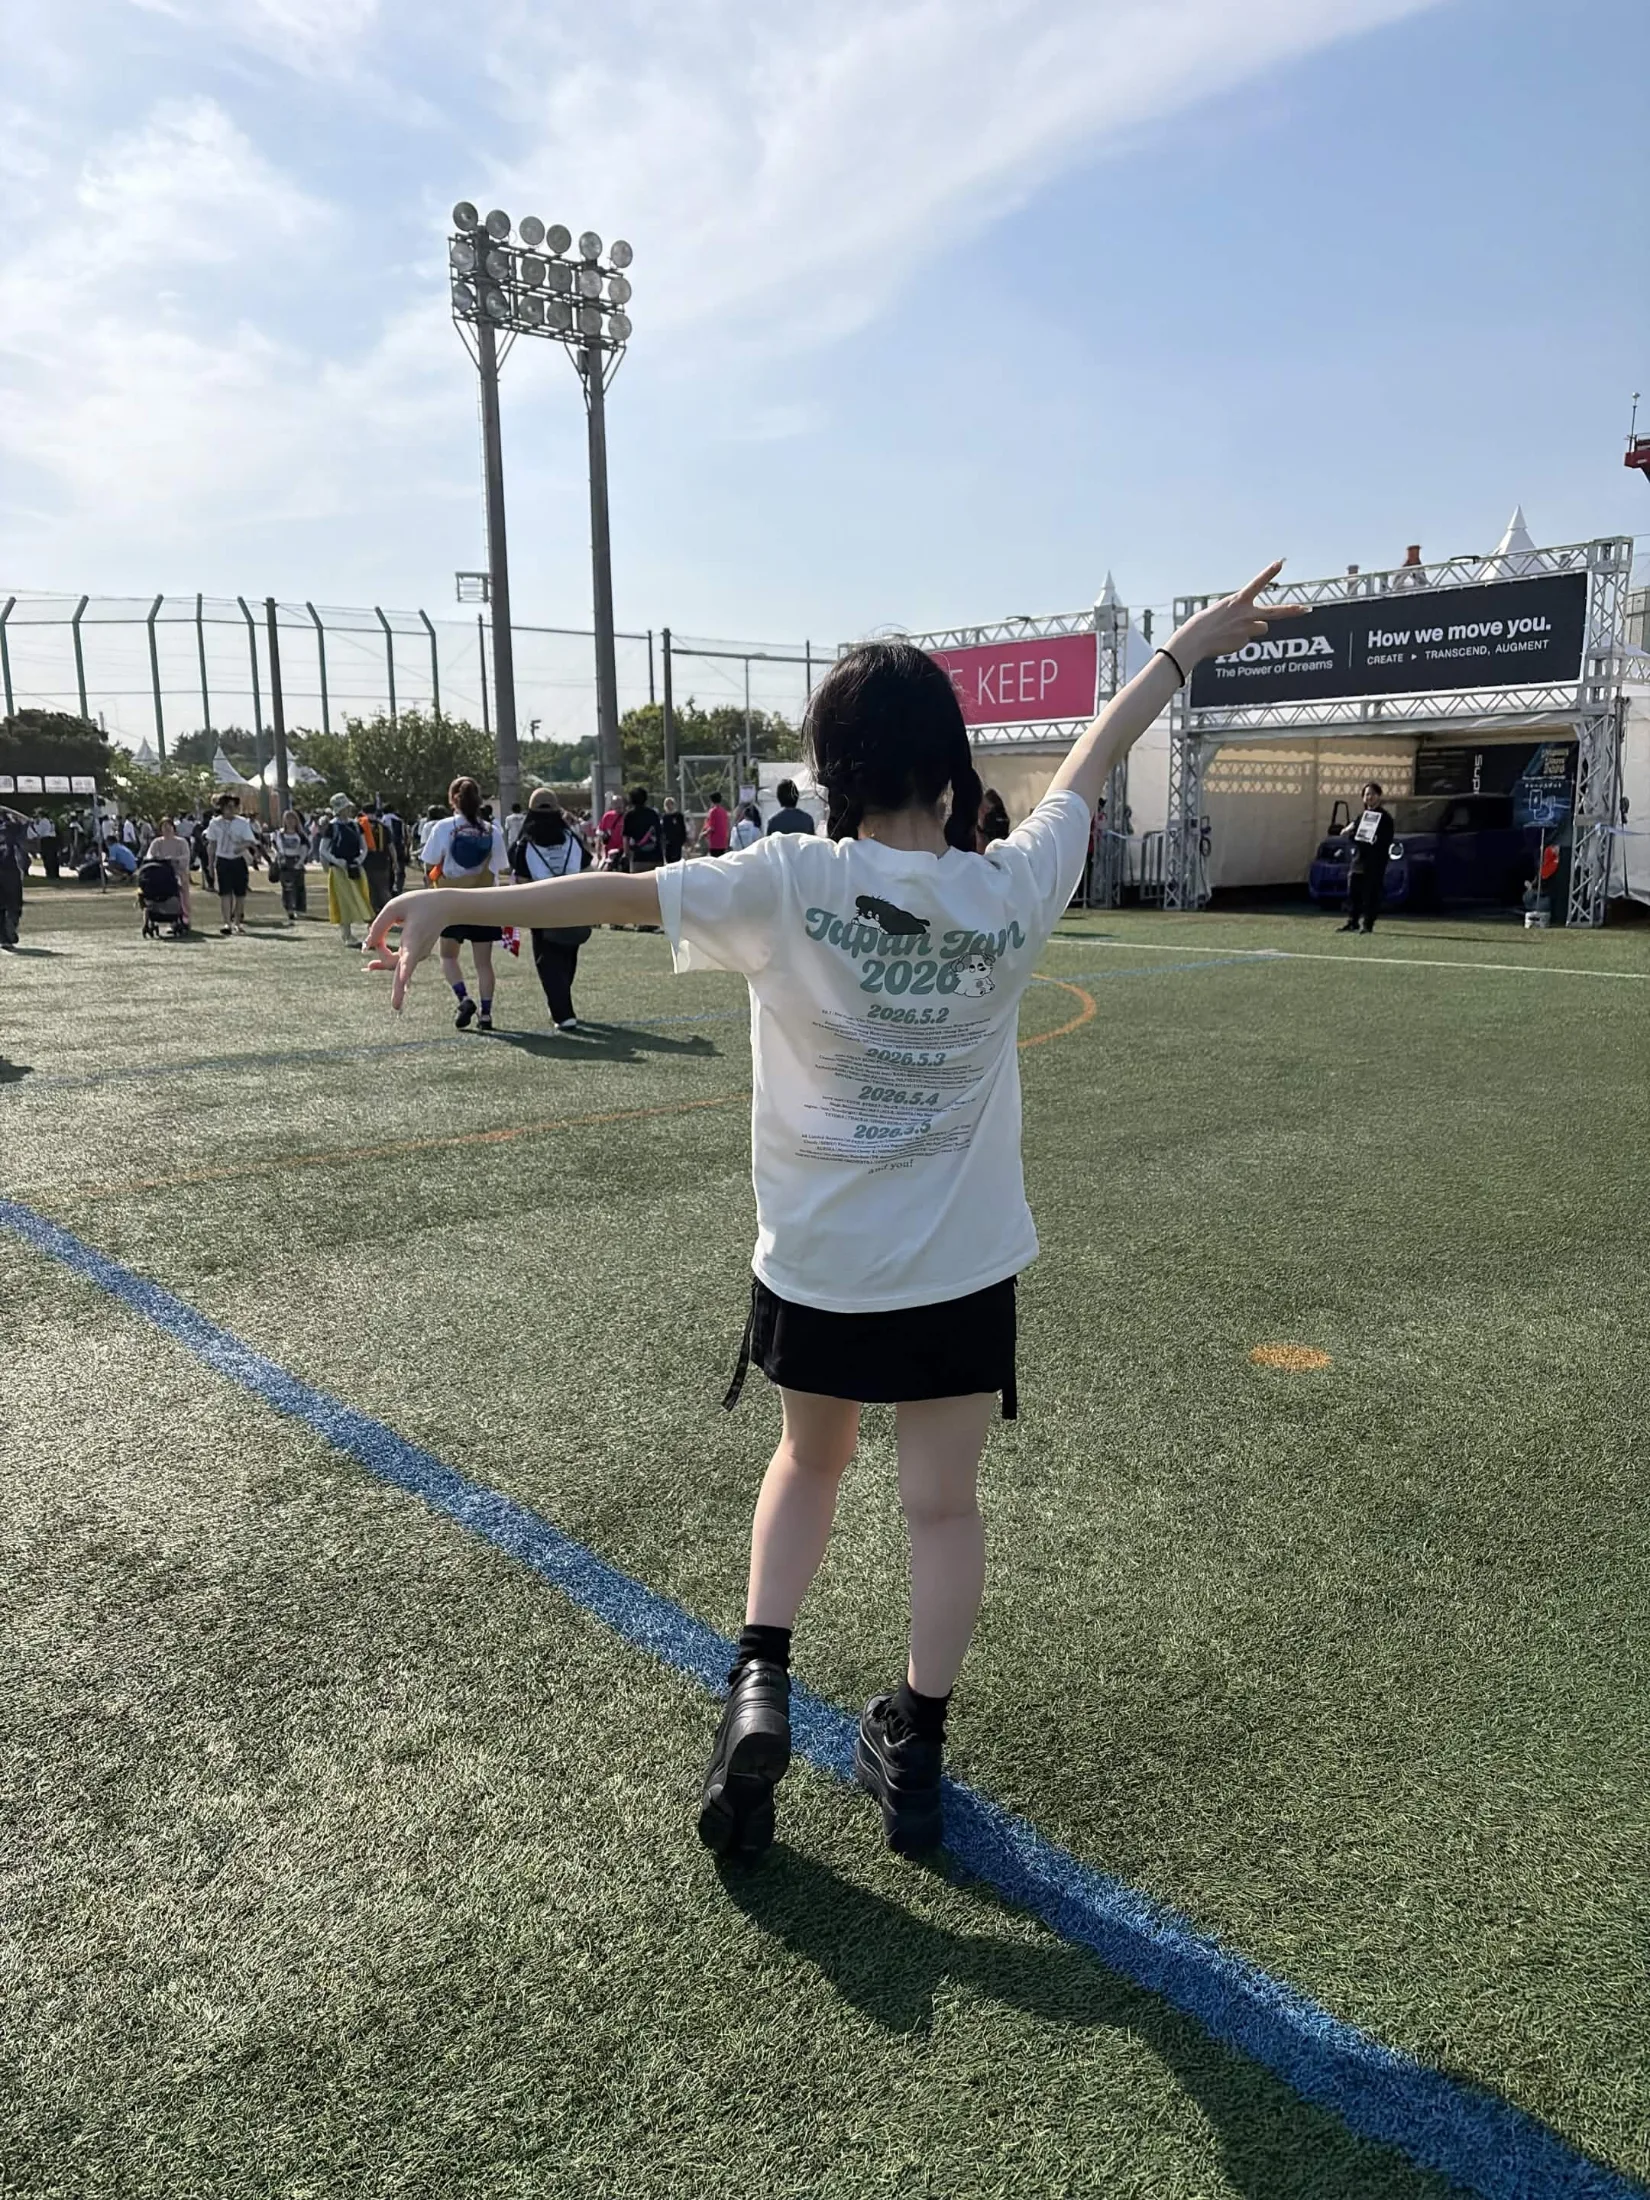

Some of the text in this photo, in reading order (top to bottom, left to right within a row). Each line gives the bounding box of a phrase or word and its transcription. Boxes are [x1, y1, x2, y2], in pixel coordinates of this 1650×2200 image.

[1368, 616, 1551, 648] How we move you.
[1367, 639, 1550, 665] CREATE TRANSCEND, AUGMENT
[978, 658, 1058, 705] KEEP
[1215, 659, 1334, 679] The Power of Dreams
[805, 907, 934, 959] Japan
[860, 959, 961, 996] 2026
[867, 1004, 949, 1025] 2026.5.2
[864, 1047, 946, 1067] 2026.5.3
[858, 1086, 940, 1106] 2026.5.4
